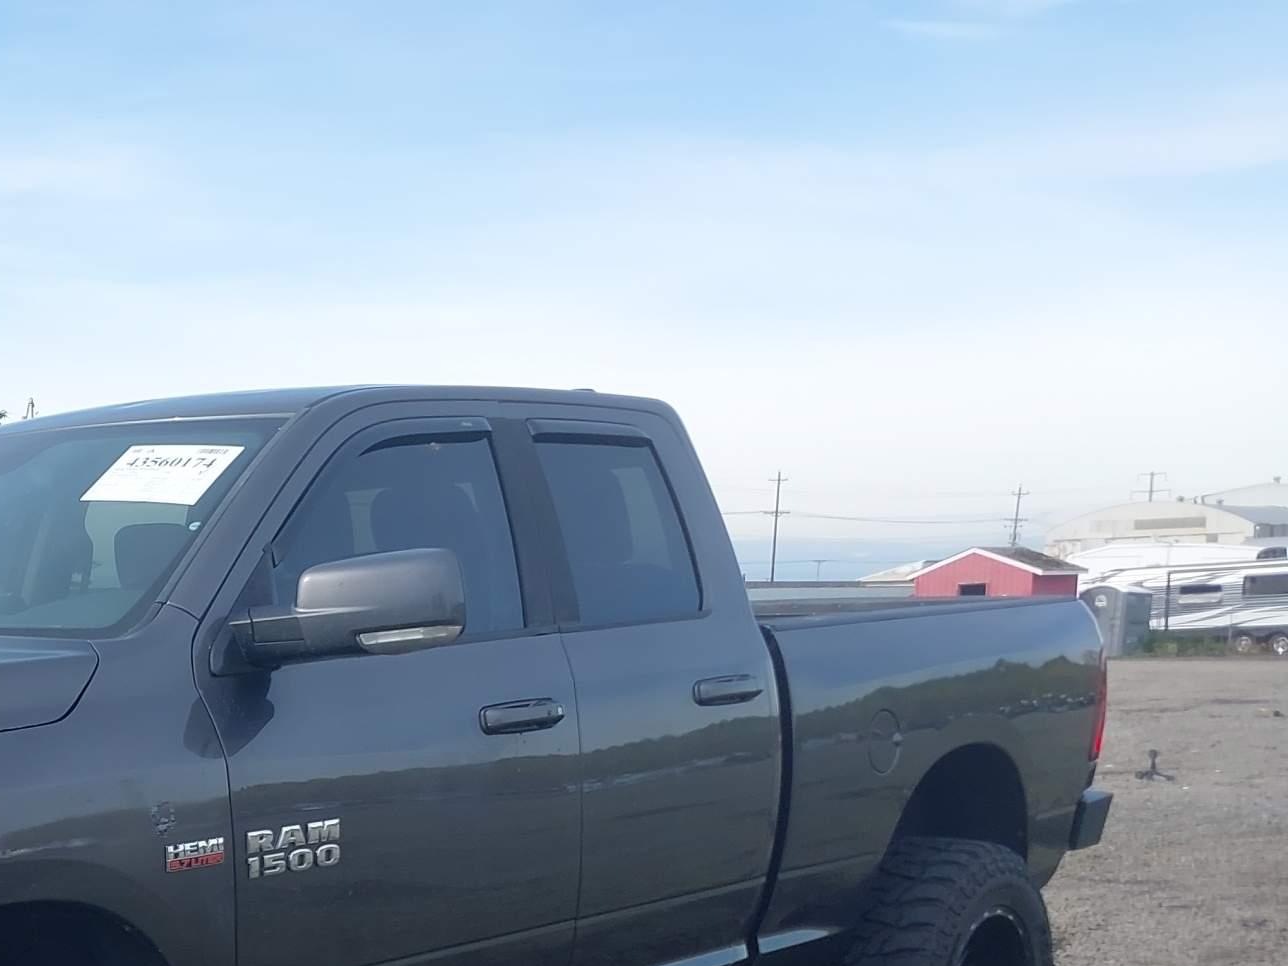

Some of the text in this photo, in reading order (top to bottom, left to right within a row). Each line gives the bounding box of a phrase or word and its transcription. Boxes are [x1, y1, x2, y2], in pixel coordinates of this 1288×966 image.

[127, 457, 217, 468] 43560174
[167, 837, 225, 860] HEMI
[247, 818, 340, 854] RAM
[248, 844, 341, 880] 1500
